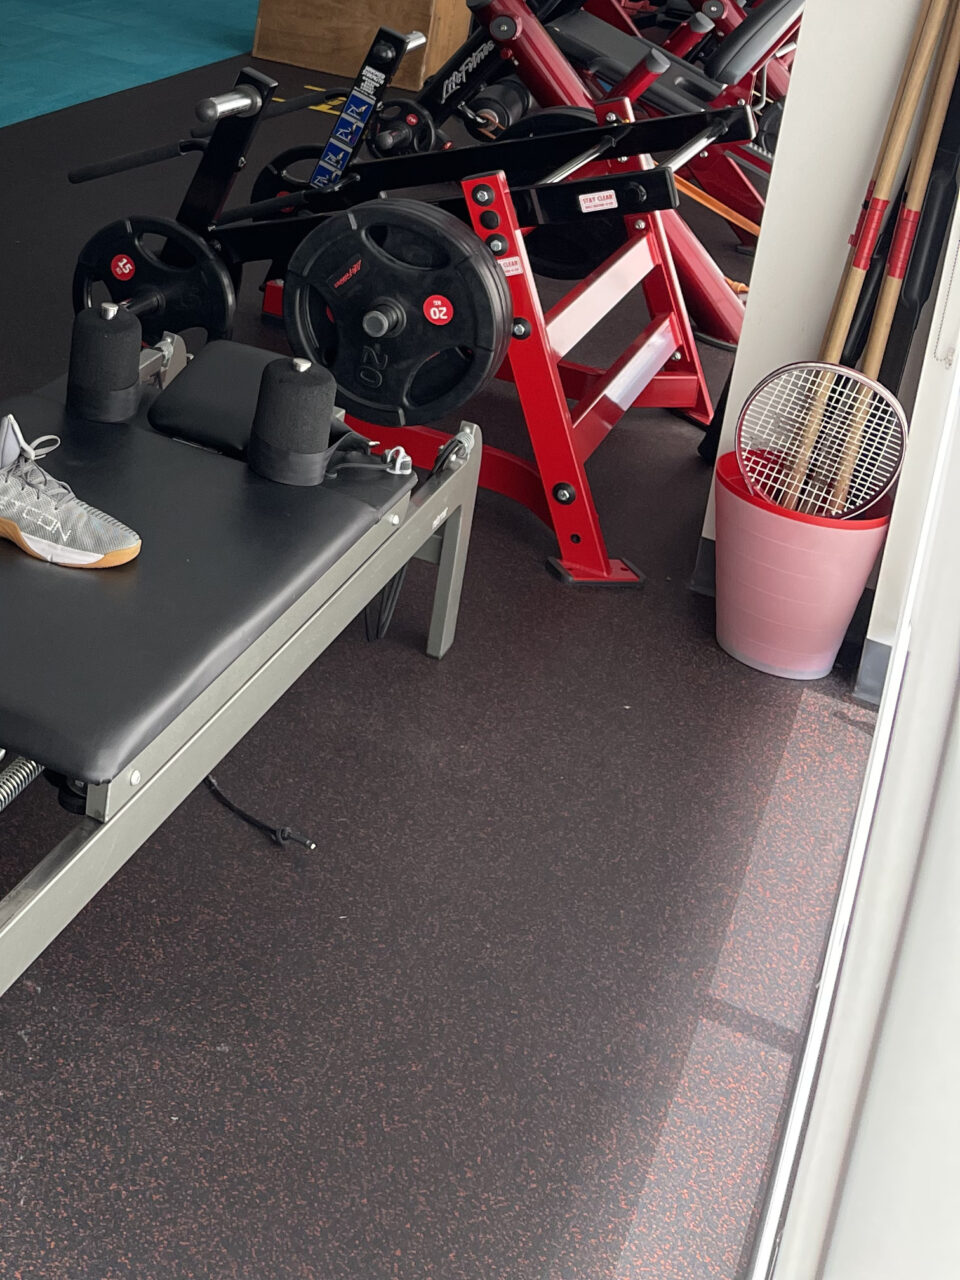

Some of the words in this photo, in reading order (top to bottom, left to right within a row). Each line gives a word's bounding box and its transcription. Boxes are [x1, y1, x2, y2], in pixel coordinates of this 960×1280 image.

[117, 258, 133, 274] 15
[429, 307, 448, 320] 20
[360, 345, 388, 388] 20
